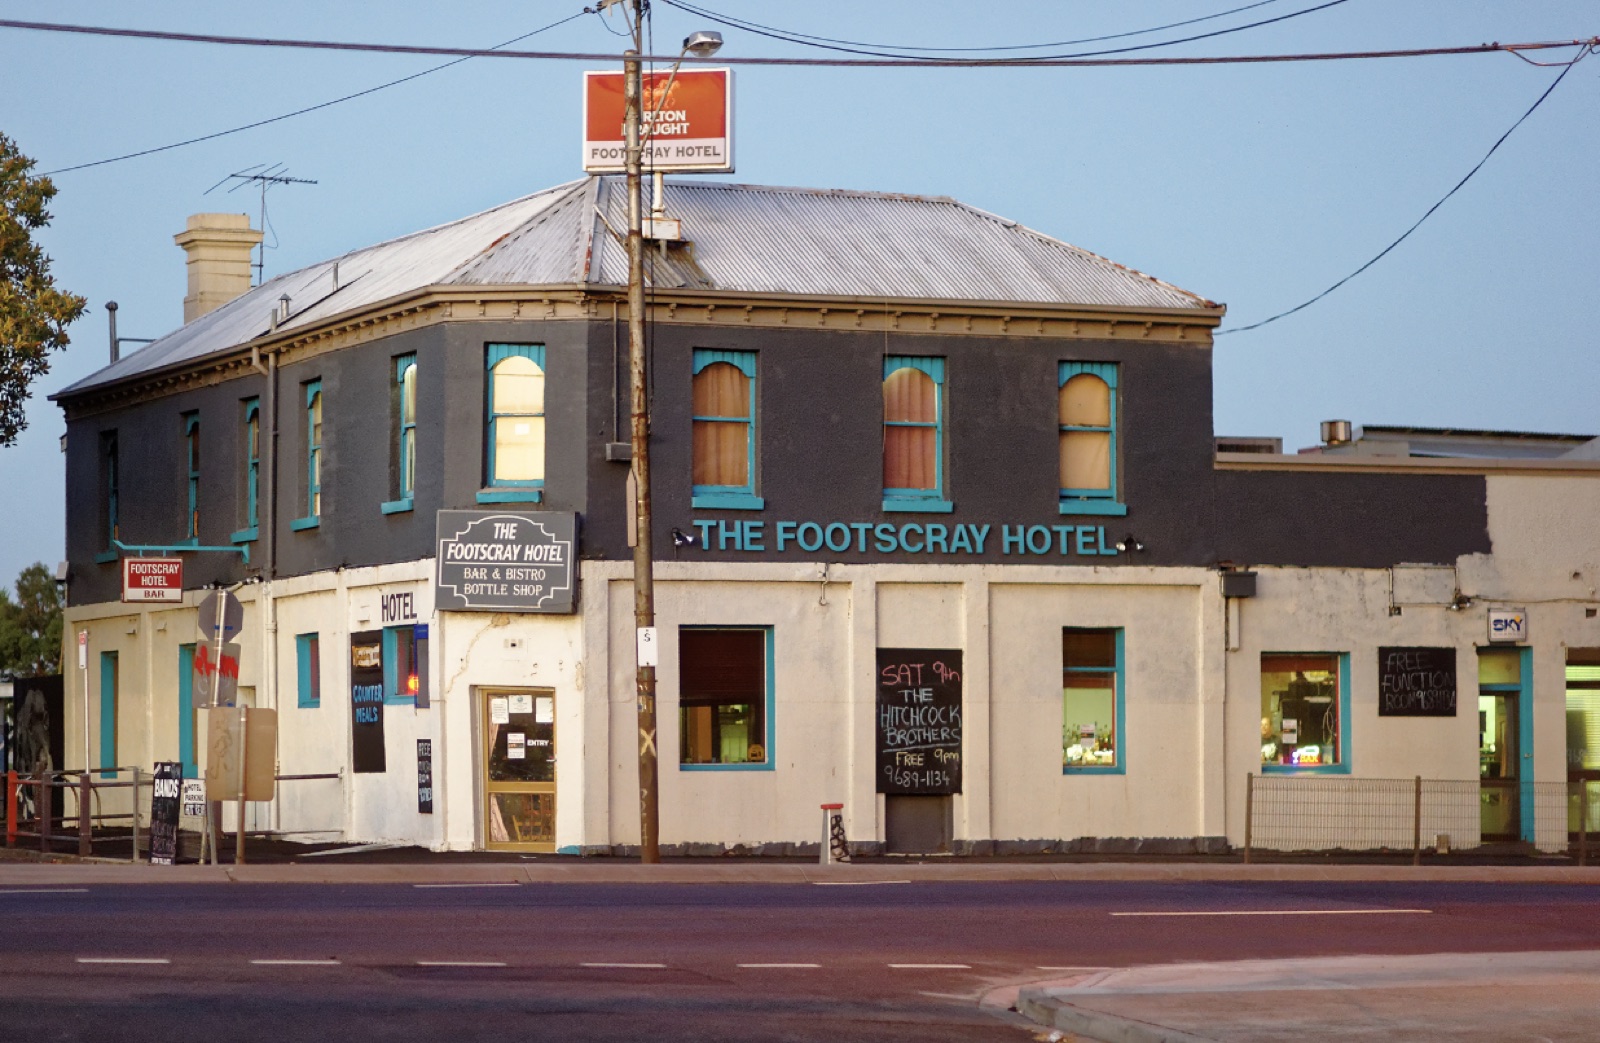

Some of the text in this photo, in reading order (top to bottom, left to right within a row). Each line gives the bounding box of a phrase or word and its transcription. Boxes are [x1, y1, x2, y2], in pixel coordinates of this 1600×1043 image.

[642, 110, 687, 122] RLTON
[676, 146, 721, 157] HOTEL
[493, 522, 518, 540] THE
[692, 519, 1118, 555] THE FOOTSCRAY HOTEL
[447, 543, 563, 562] FOOTSCRAY HOTEL
[130, 563, 180, 574] FOOTSCRAY
[463, 567, 546, 581] BAR & BISTRO
[141, 575, 168, 586] HOTEL
[144, 590, 165, 598] BAR
[463, 583, 543, 596] BOTTLE SHOP
[381, 591, 418, 621] HOTEL
[1493, 618, 1523, 631] SKY
[1384, 651, 1433, 672] FREE
[882, 661, 960, 686] SAT 9th
[1381, 672, 1454, 692] FUNCTION
[353, 684, 382, 703] COUNTER
[898, 688, 933, 703] THE
[356, 706, 378, 722] MEALS
[881, 704, 962, 729] HITCHCOCK
[526, 739, 549, 747] ENTRY
[884, 727, 961, 745] BROTHERS
[896, 749, 959, 766] FREE 9pm
[884, 765, 950, 788] 9689-1134
[154, 779, 179, 799] BANDS
